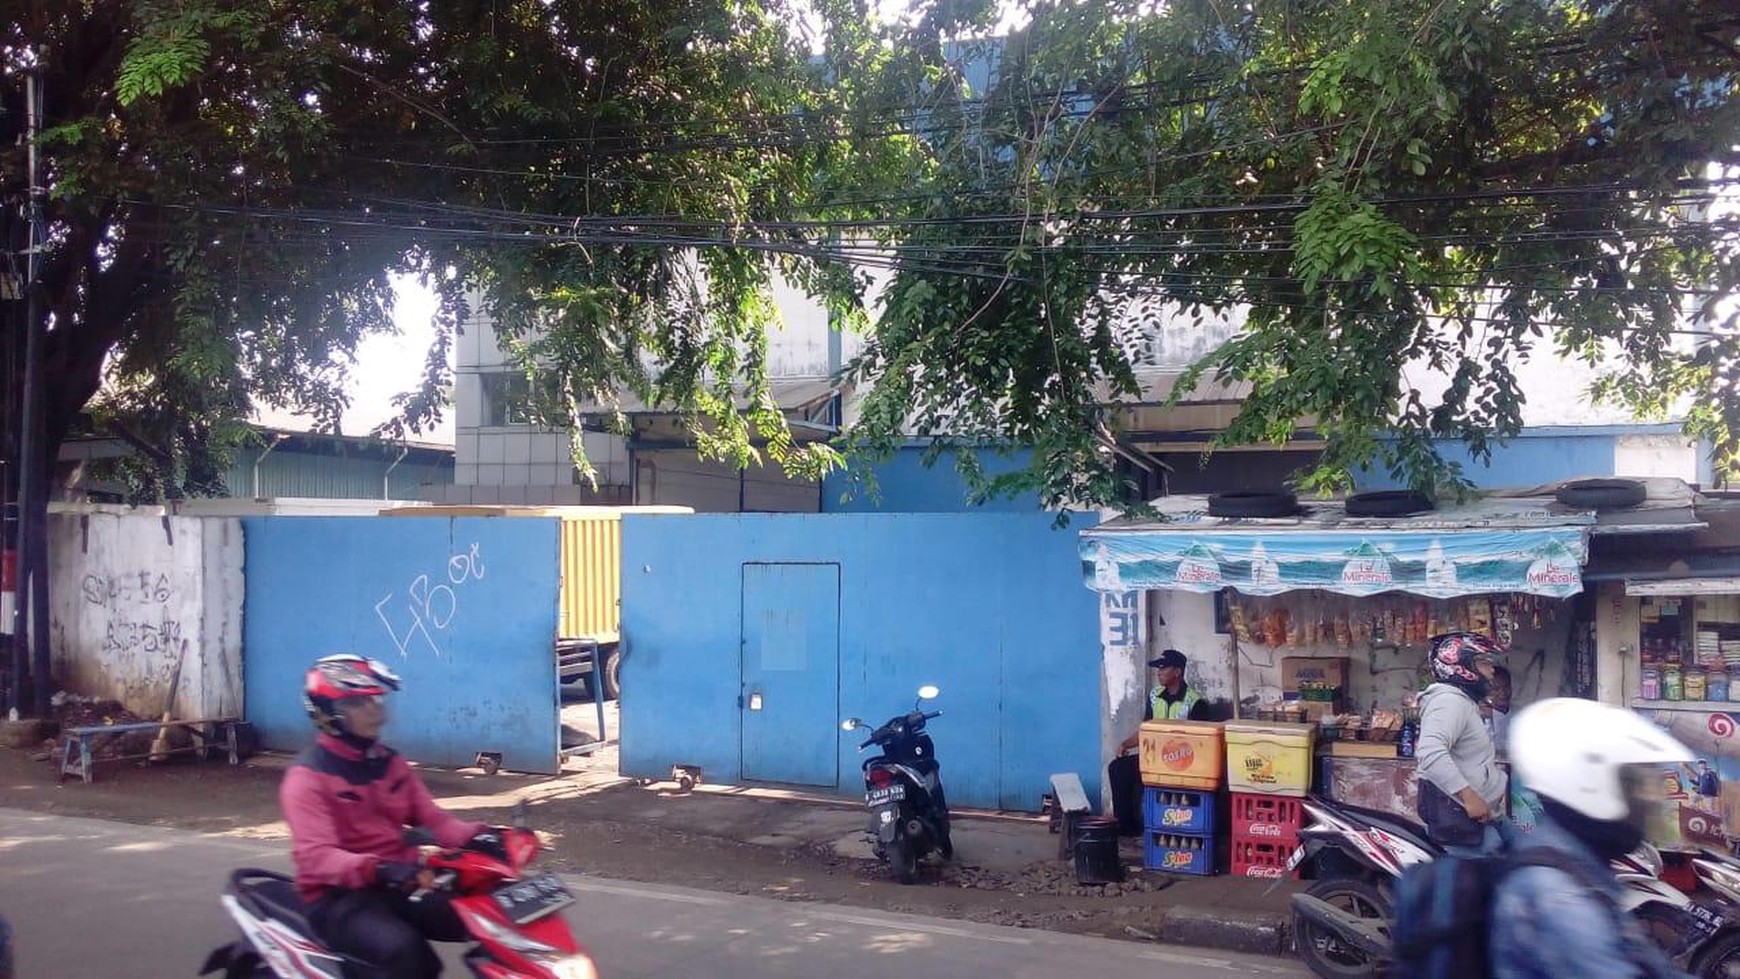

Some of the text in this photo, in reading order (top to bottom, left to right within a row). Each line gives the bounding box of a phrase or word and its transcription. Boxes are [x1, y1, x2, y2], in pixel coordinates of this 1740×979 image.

[1360, 564, 1373, 573] Le
[1546, 563, 1560, 574] Le
[1343, 571, 1392, 583] Minerale
[1529, 571, 1578, 583] Minerale
